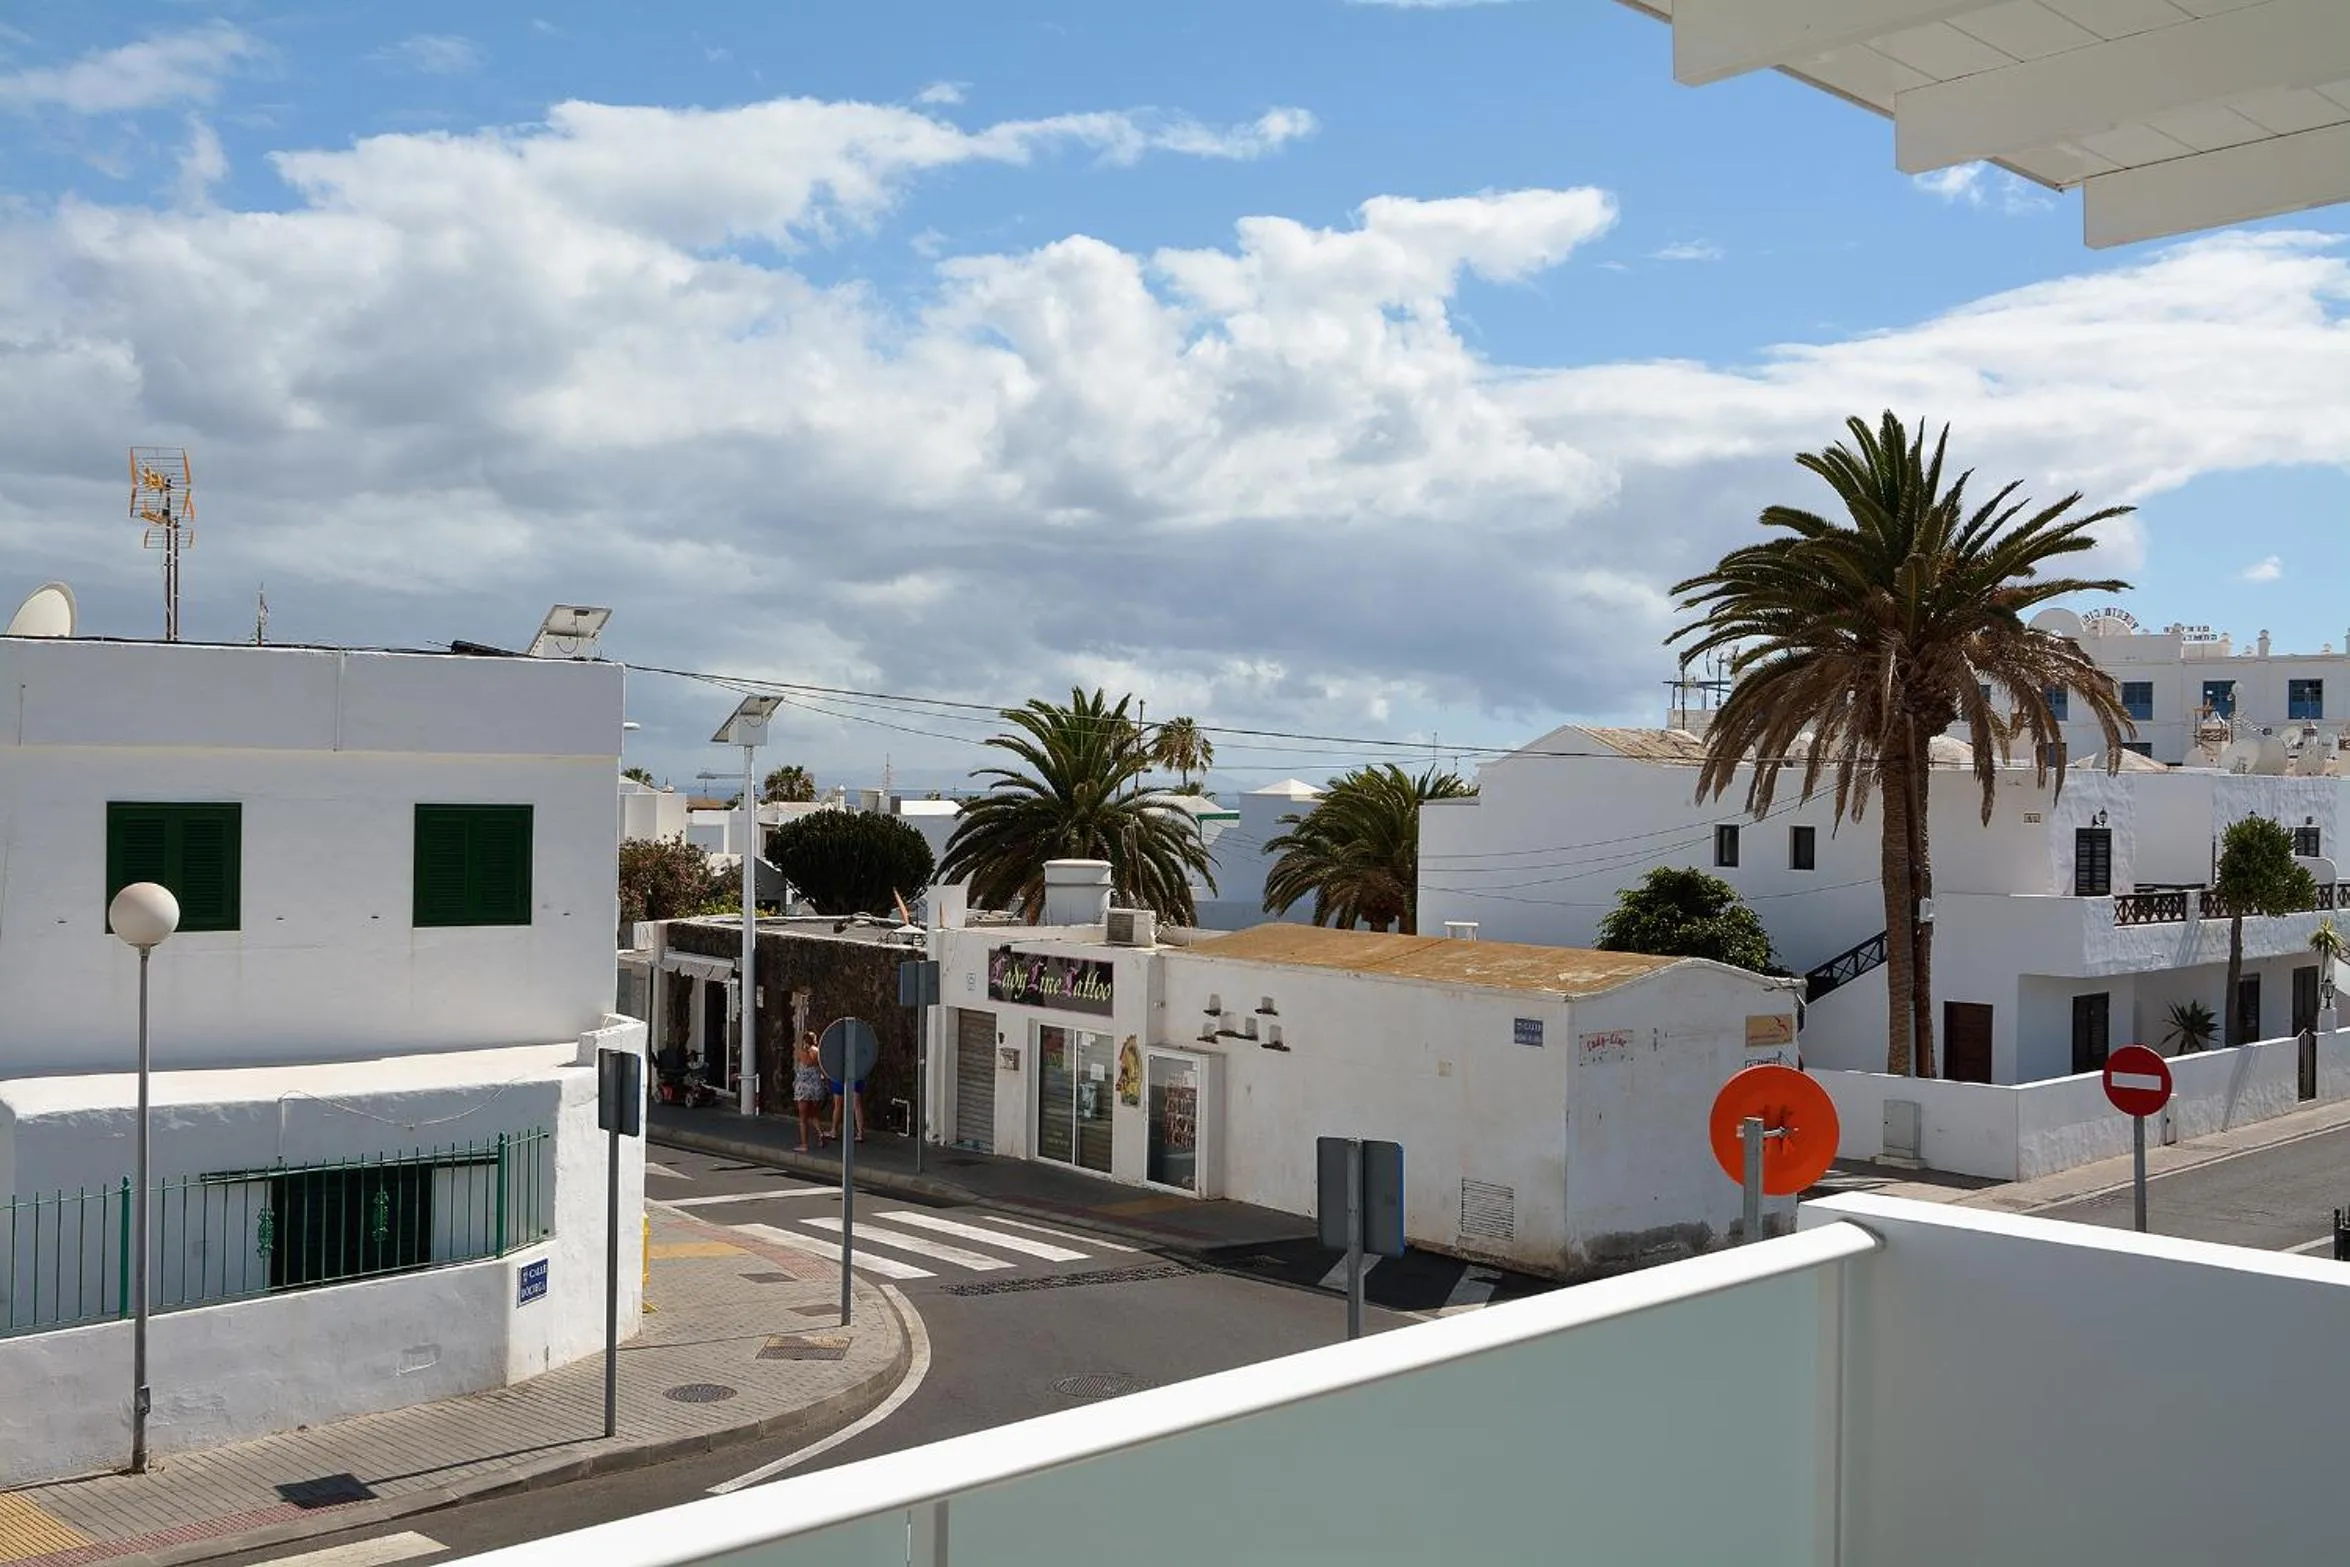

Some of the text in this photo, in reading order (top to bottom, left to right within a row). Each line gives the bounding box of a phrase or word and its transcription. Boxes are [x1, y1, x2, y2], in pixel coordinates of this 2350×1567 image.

[990, 955, 1112, 1001] Lady Line Tattoo
